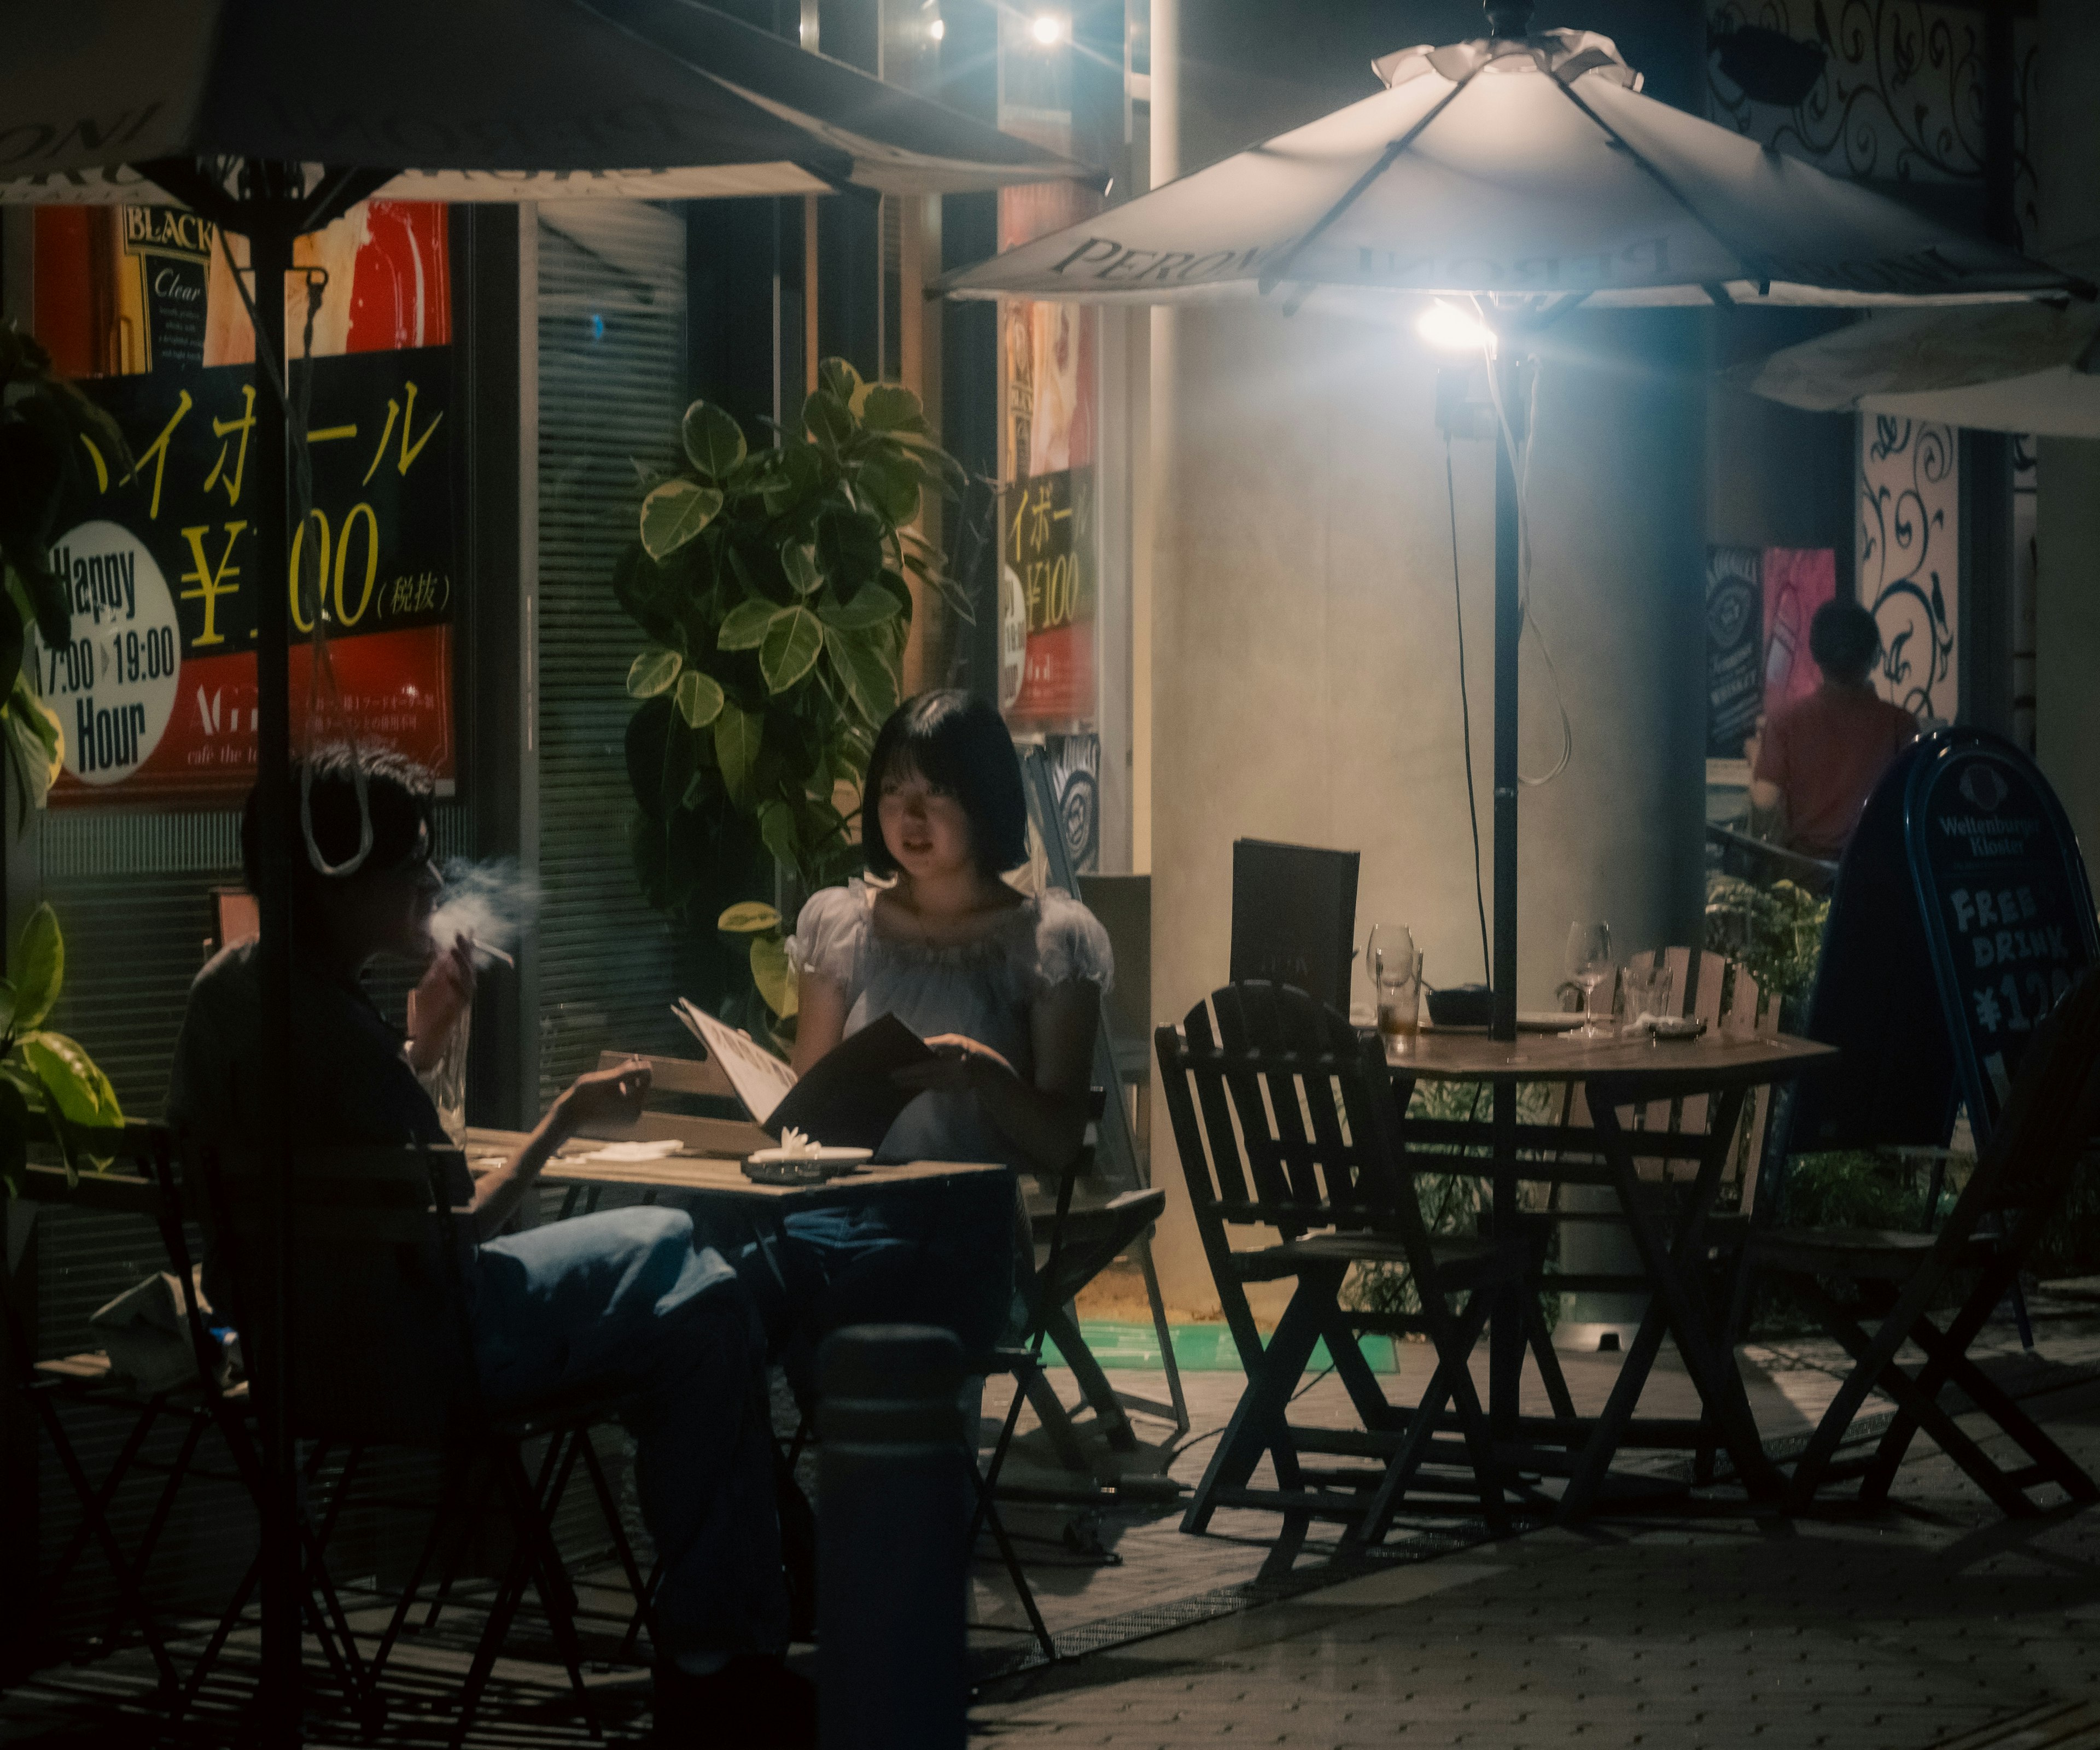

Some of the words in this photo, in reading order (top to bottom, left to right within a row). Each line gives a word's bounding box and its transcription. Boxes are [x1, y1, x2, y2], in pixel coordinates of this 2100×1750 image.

[126, 206, 212, 253] BLACK
[154, 267, 201, 301] Clear
[54, 546, 135, 625] Happy
[180, 501, 380, 648] ¥00
[113, 625, 175, 684] 19:00
[76, 697, 146, 773] Hour
[1950, 884, 2039, 933] FREE
[1972, 924, 2070, 970] DRINK
